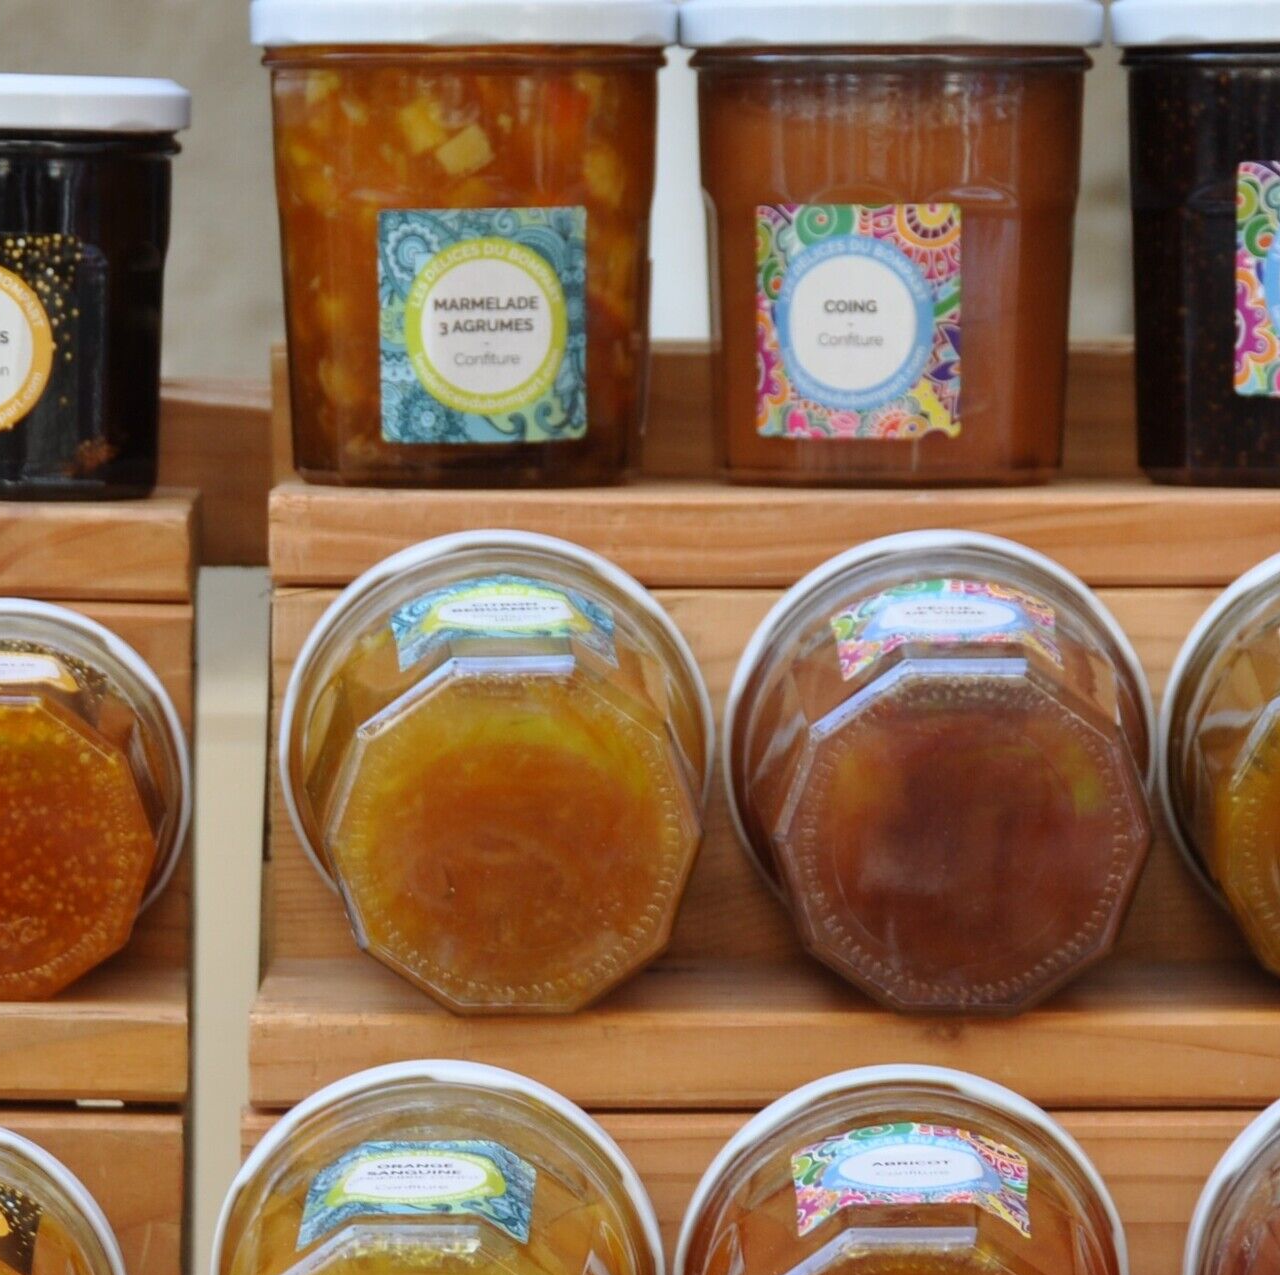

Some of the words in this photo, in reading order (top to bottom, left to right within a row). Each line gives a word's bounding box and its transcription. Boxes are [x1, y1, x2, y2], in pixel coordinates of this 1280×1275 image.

[482, 242, 506, 256] DU
[433, 295, 540, 312] MARMELADE
[823, 299, 878, 314] COING
[439, 322, 449, 336] 3
[452, 317, 535, 334] AGRUMES
[816, 332, 885, 347] Confiture
[453, 351, 522, 367] Confiture
[376, 1162, 452, 1170] ORANGE
[872, 1159, 950, 1168] ABRICOT
[366, 1169, 460, 1177] SANGUINE
